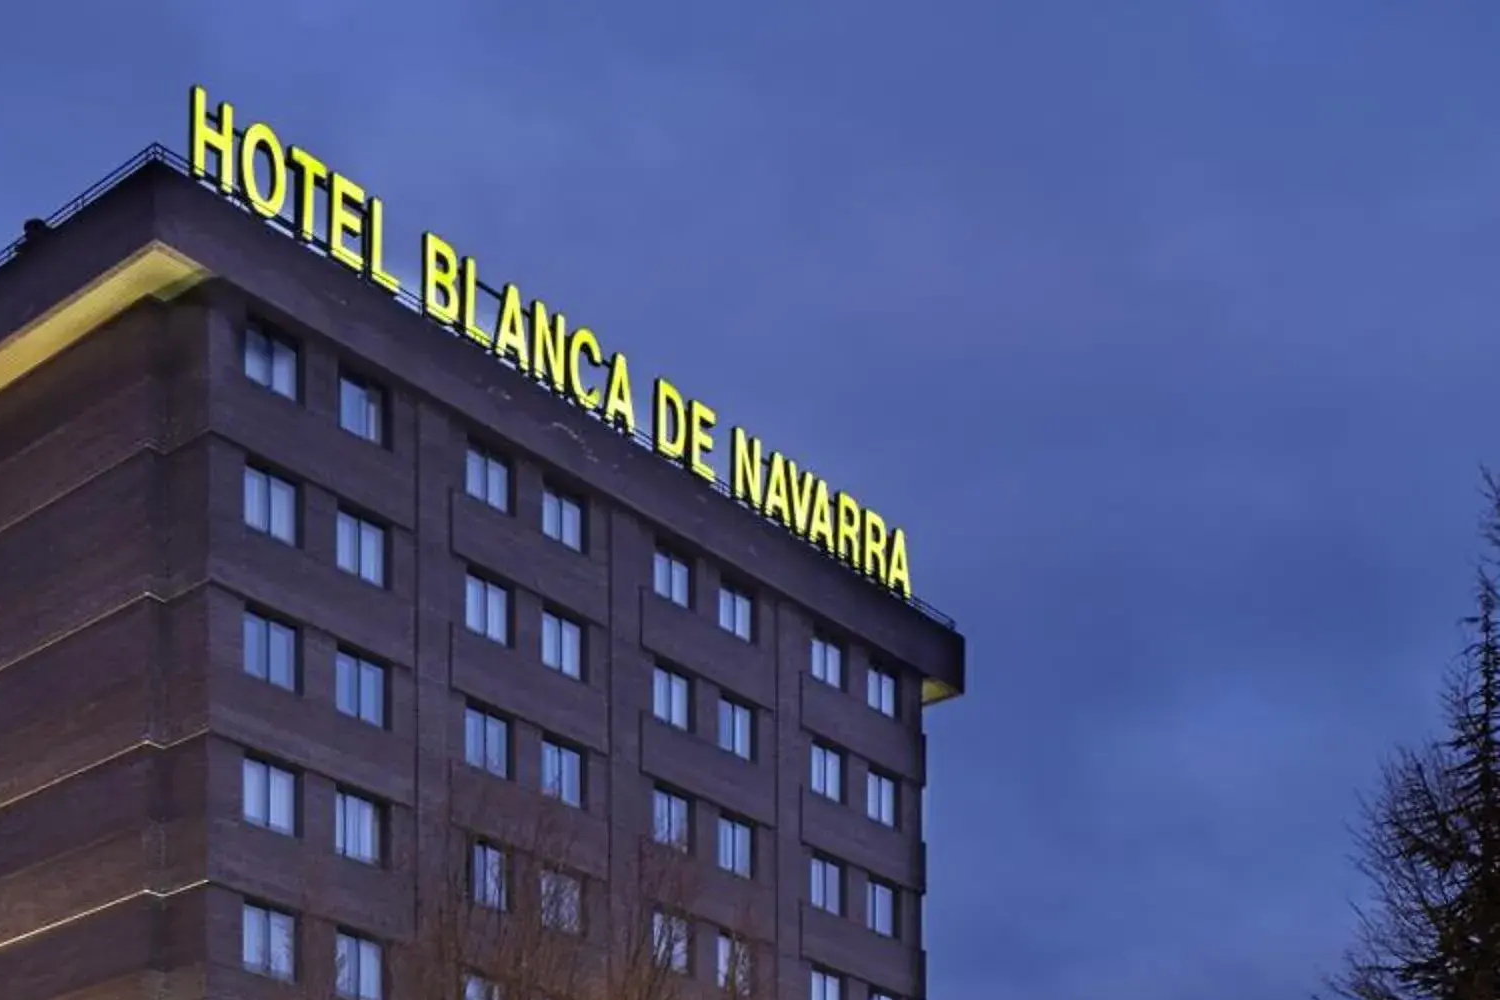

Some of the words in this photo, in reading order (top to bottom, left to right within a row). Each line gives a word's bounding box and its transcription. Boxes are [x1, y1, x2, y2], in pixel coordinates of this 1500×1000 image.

[190, 85, 400, 294] HOTEL
[423, 232, 635, 432] BLANCA
[654, 379, 717, 482] DE
[731, 427, 912, 598] NAVARRA
